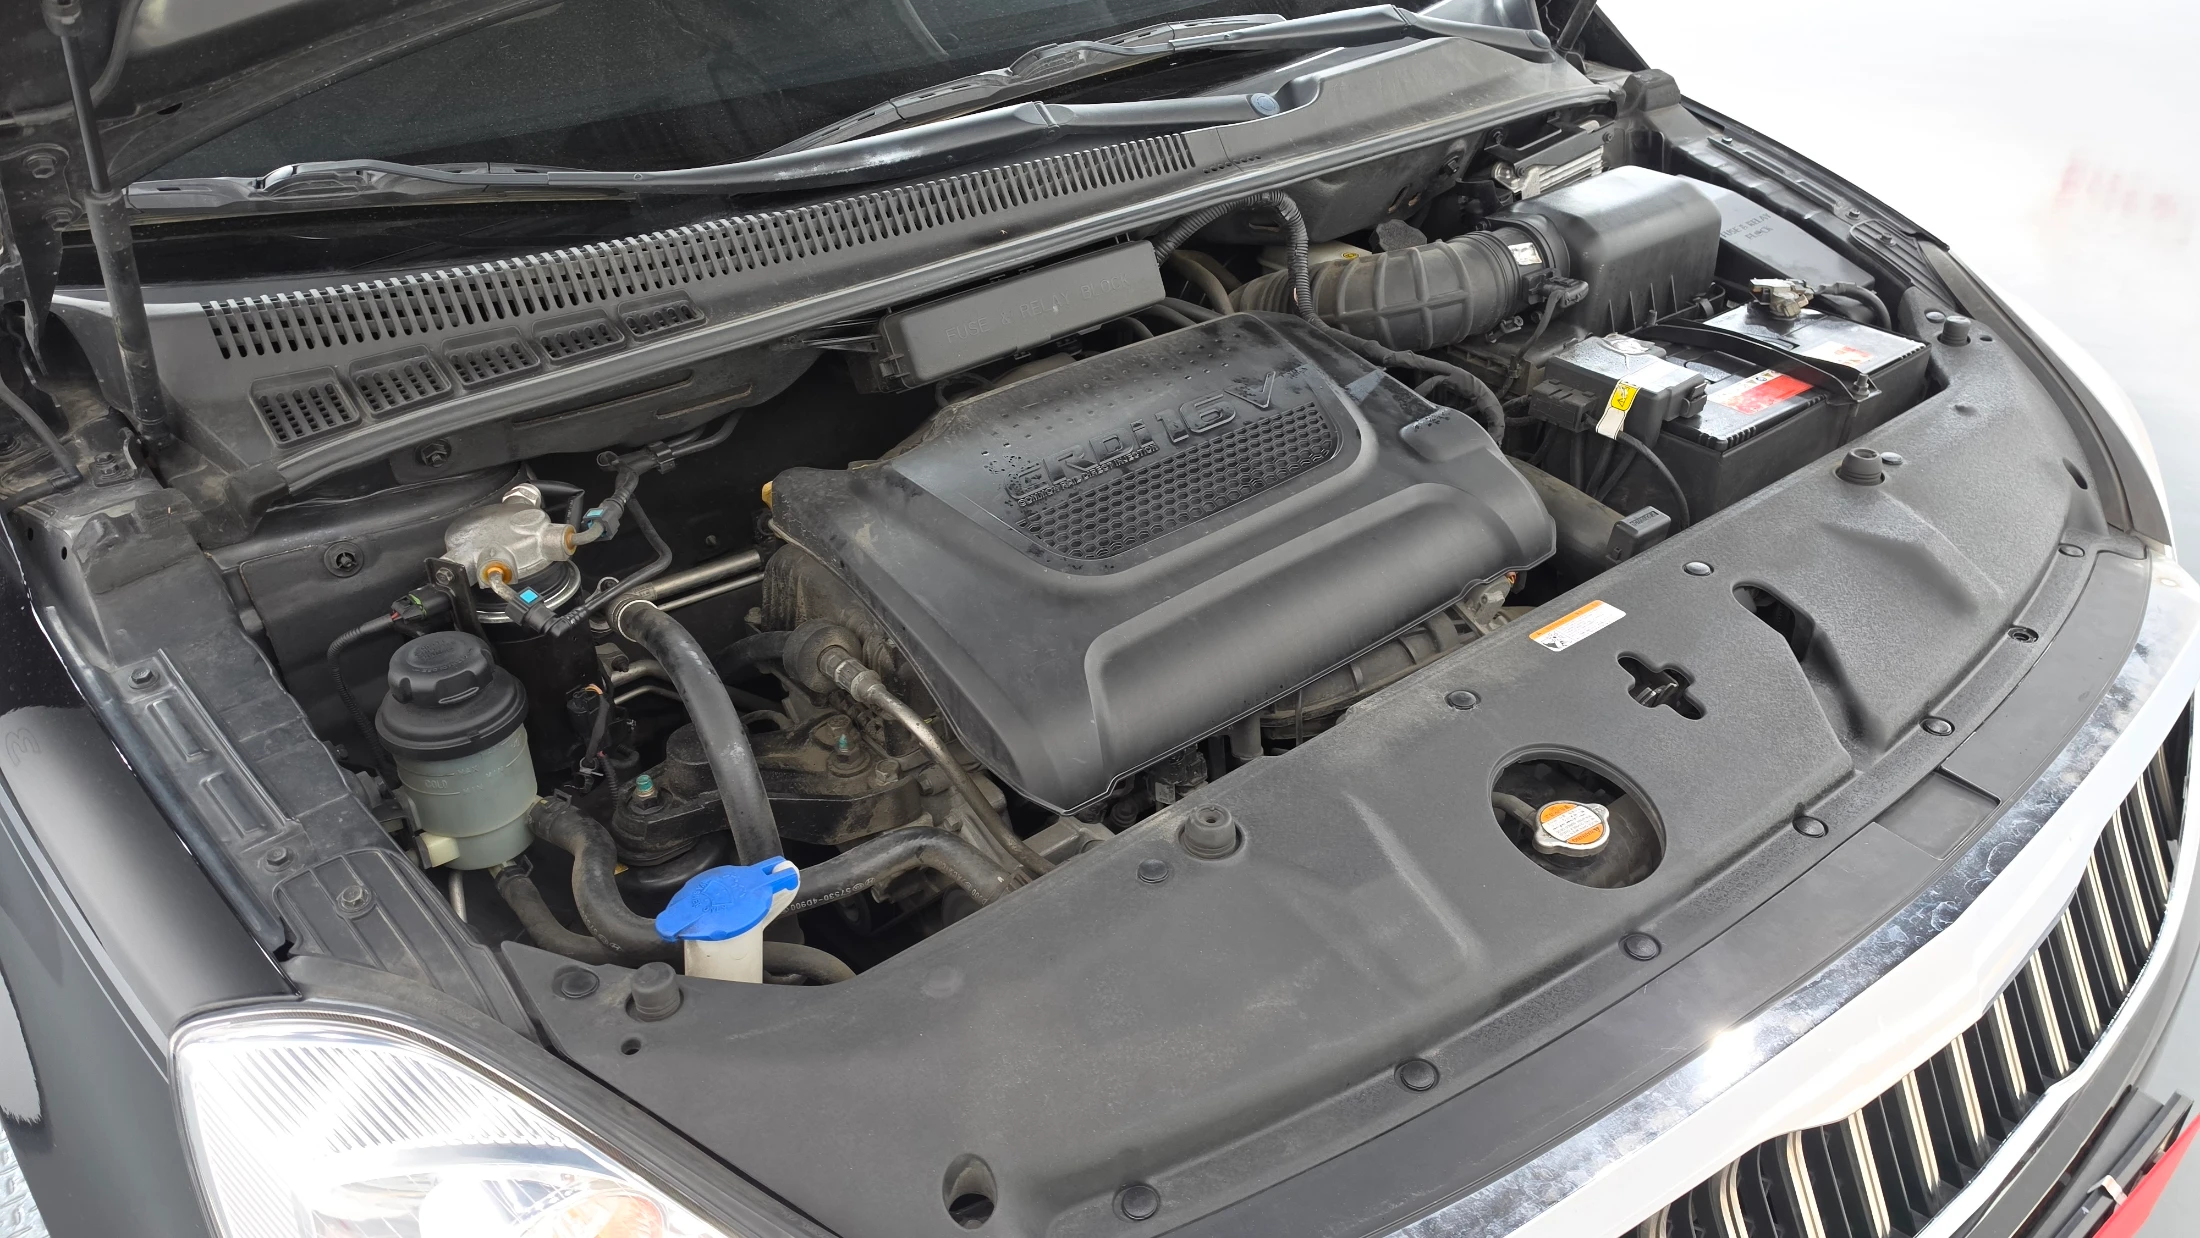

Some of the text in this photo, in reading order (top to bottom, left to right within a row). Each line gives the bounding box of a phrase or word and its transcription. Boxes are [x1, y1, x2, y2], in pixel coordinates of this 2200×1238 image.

[945, 273, 1130, 343] FUSE & RELAY BLOCK
[1155, 370, 1277, 443] 16V
[1081, 462, 1113, 481] DIRECT
[1113, 443, 1159, 467] INJECTION
[457, 764, 480, 776] MAX
[424, 779, 448, 790] COLD
[462, 783, 484, 795] MIN
[790, 887, 851, 911] 57530-4D900
